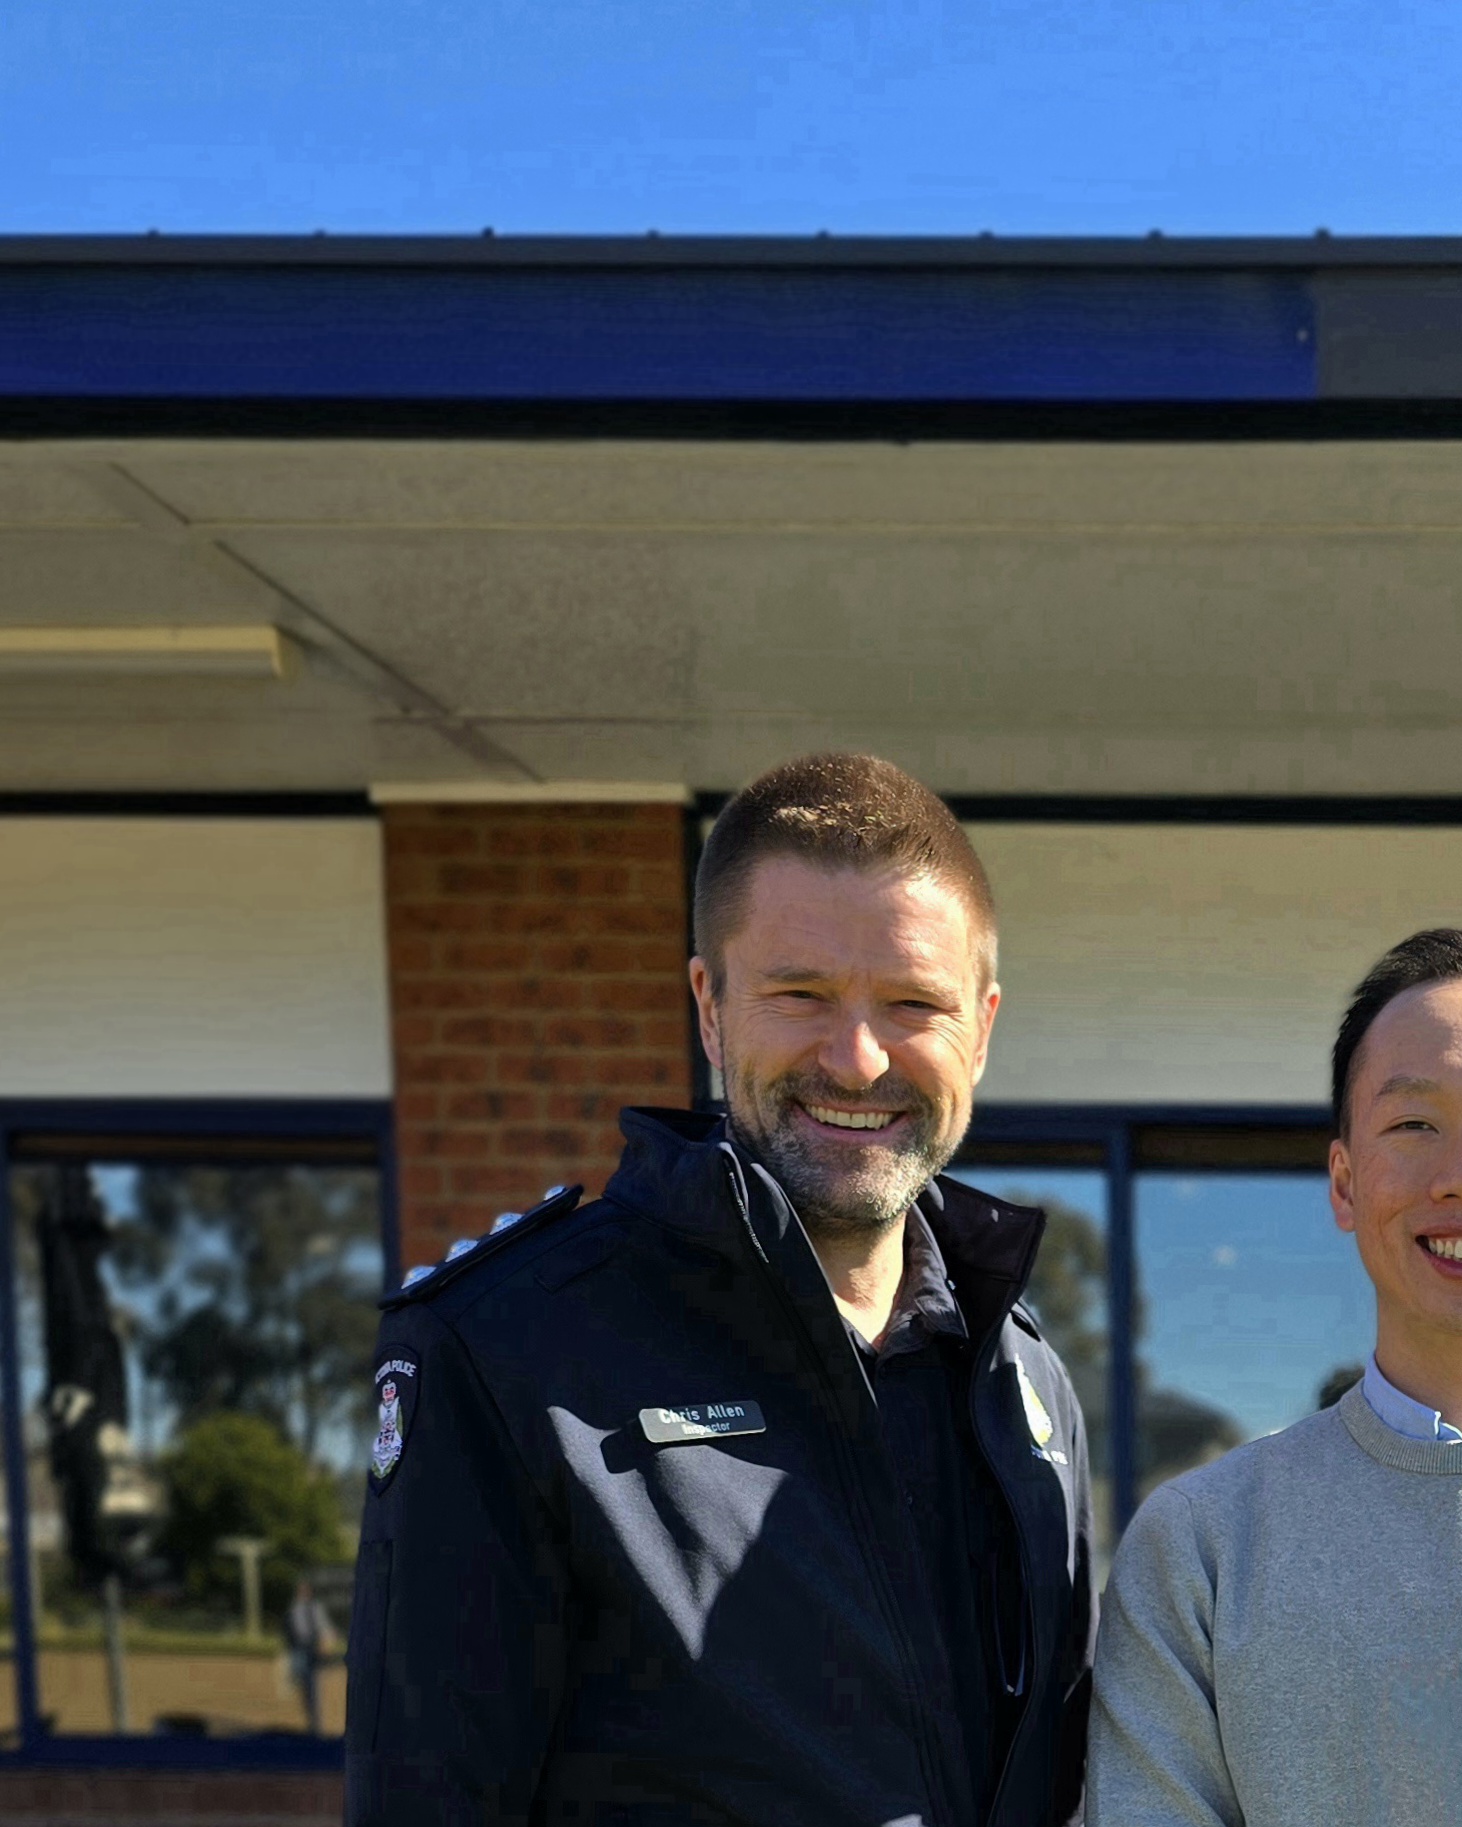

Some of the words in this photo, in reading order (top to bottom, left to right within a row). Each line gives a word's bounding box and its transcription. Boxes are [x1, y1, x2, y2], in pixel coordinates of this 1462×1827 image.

[659, 1408, 700, 1423] Chris
[706, 1404, 745, 1419] Allen
[681, 1421, 731, 1435] Inspector
